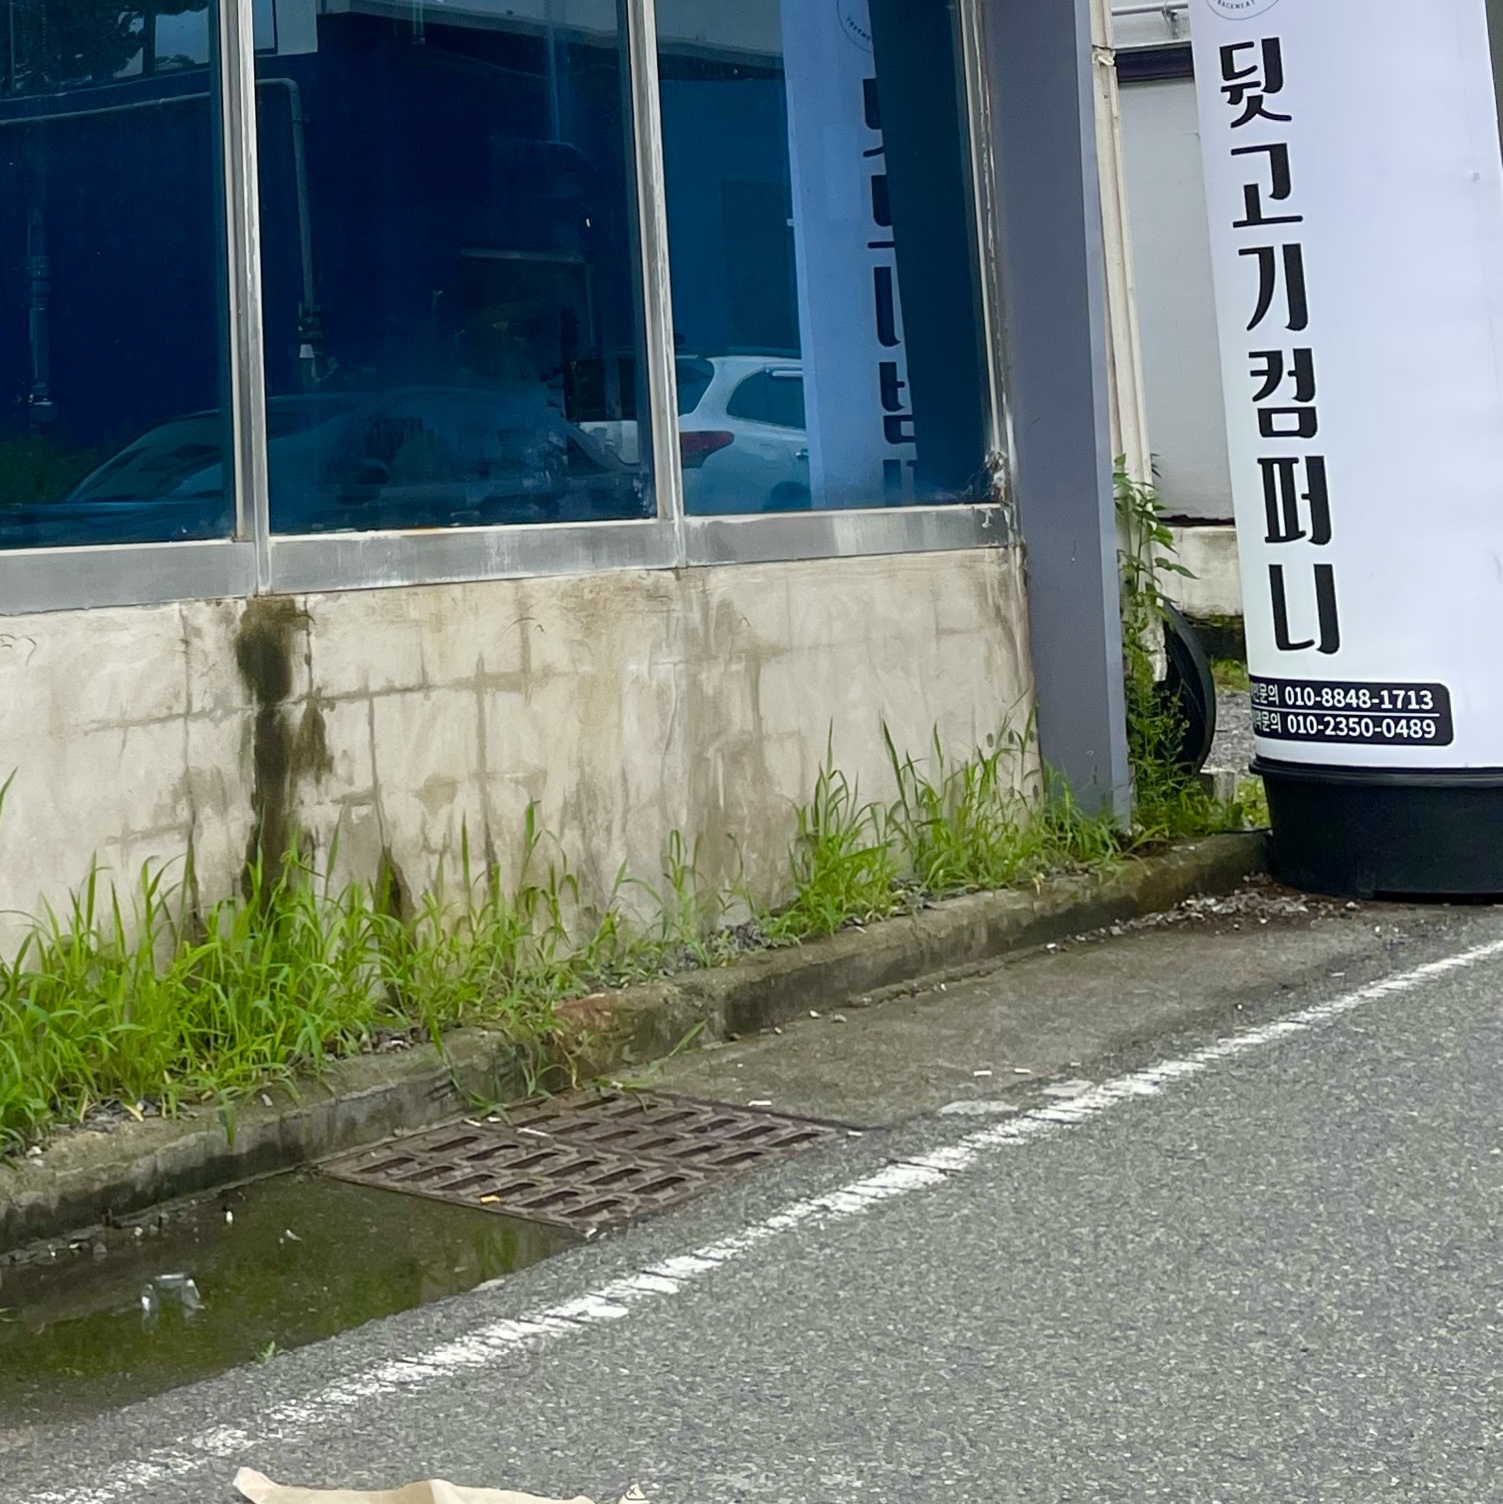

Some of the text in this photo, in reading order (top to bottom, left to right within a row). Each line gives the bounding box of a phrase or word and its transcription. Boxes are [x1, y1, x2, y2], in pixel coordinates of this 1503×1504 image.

[1218, 36, 1341, 656] 뒷고기컴퍼니
[1284, 685, 1435, 710] 010-8848-1713
[1287, 714, 1437, 739] 010-2350-0489
